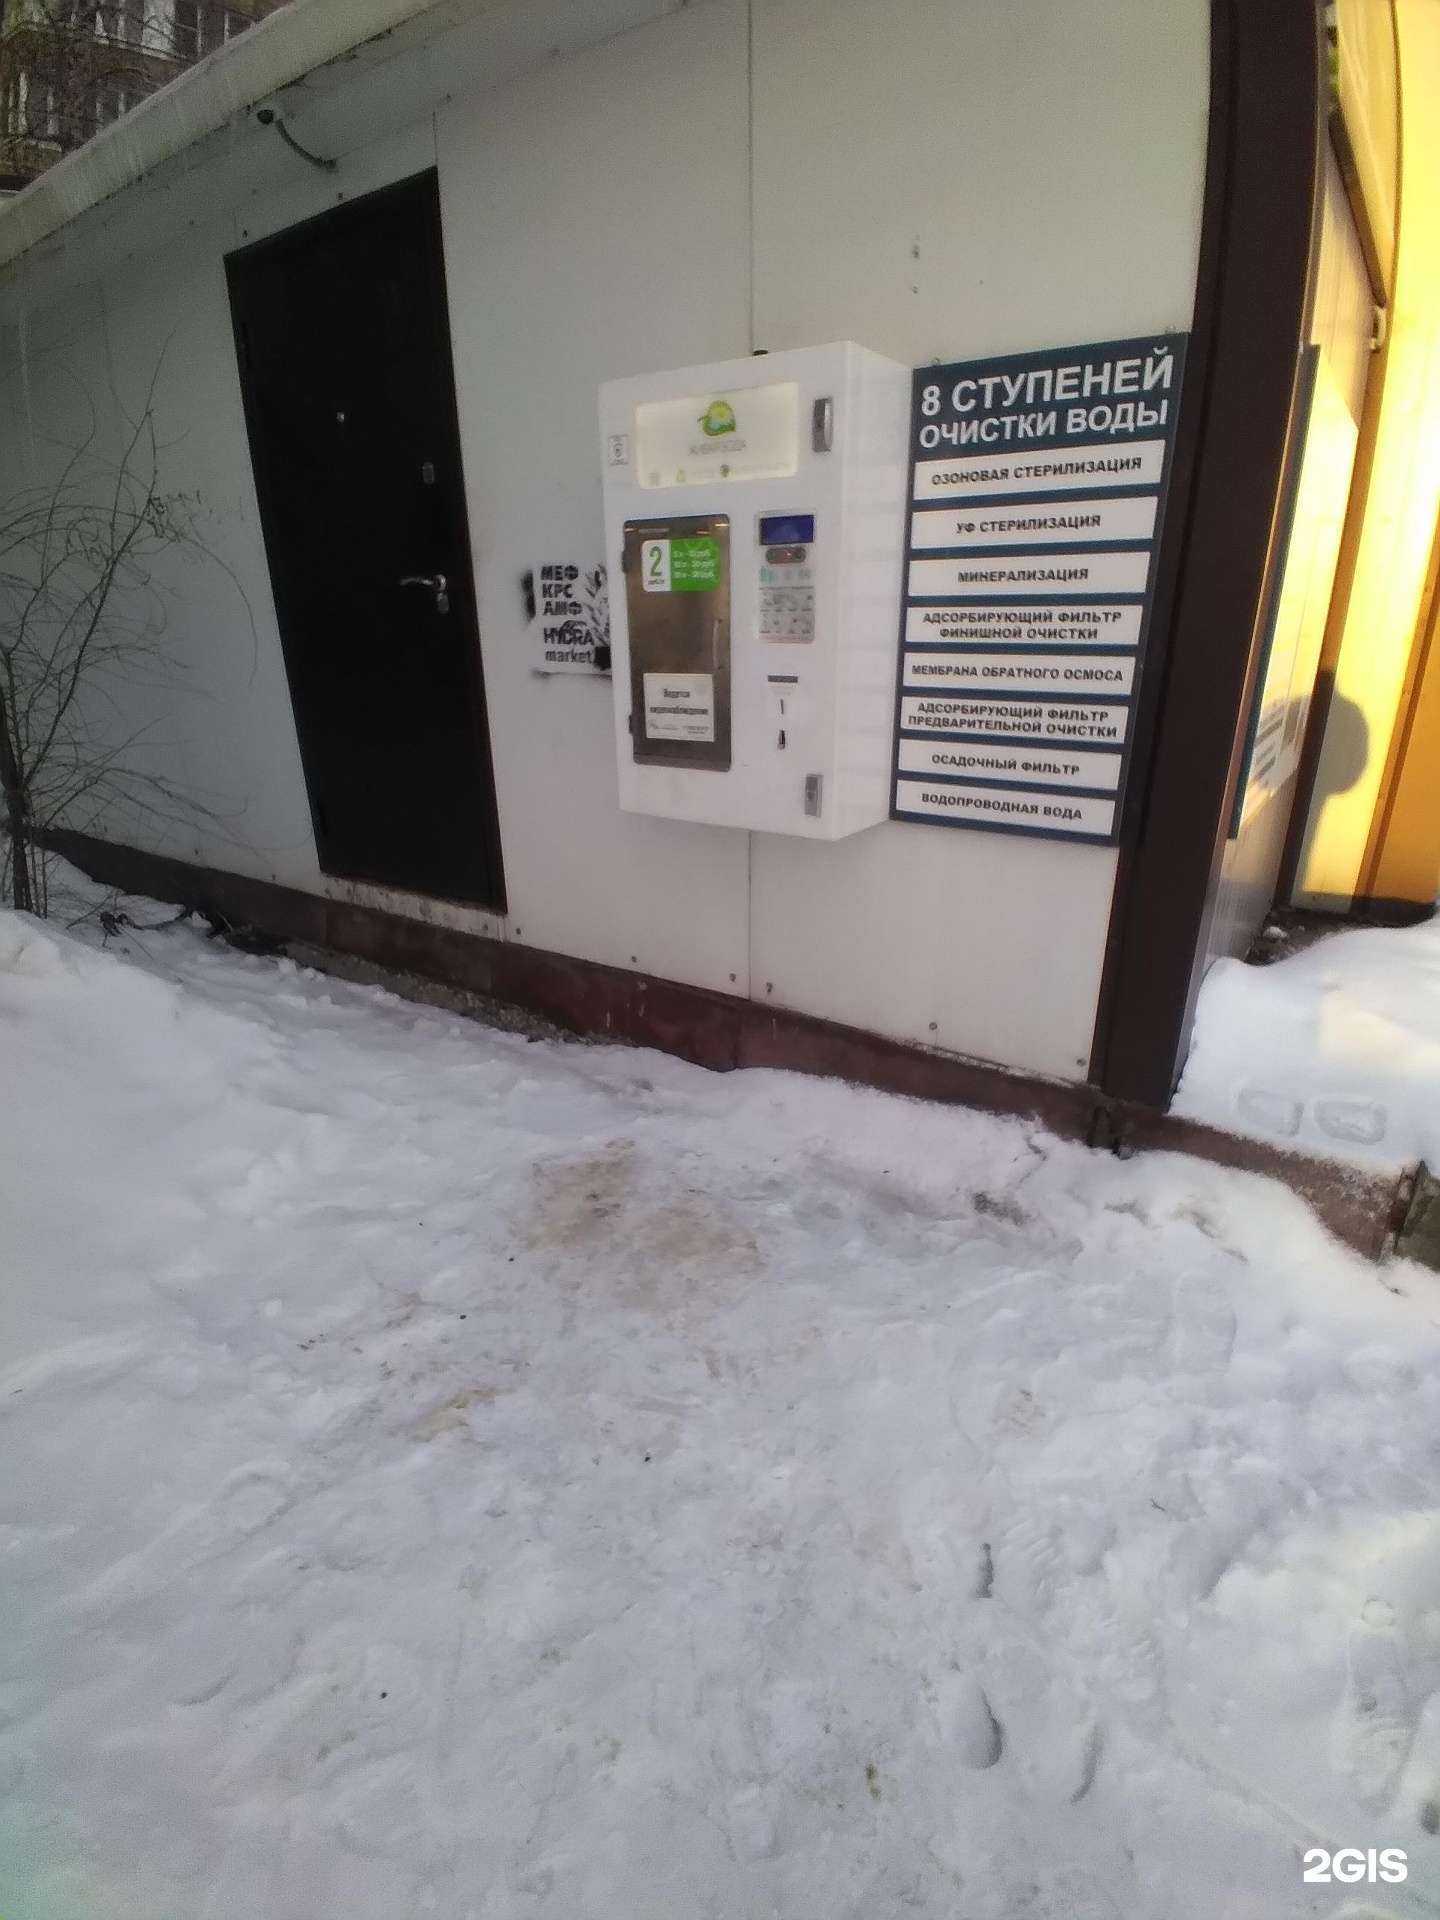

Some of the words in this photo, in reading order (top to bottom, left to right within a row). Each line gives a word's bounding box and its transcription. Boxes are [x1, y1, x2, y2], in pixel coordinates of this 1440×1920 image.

[921, 385, 941, 416] 8
[951, 346, 1174, 412] СТУПЕНЕЙ
[919, 411, 1057, 448] ОЧИСТКИ
[1066, 399, 1168, 434] ВОДЫ
[931, 468, 1008, 486] ОЗОНОВАЯ
[1013, 457, 1142, 479] СТЕРИЛИЗАЦИЯ
[956, 522, 975, 534] УФ
[980, 515, 1101, 533] СТЕРИЛИЗАЦИЯ
[649, 546, 662, 576] 2
[957, 568, 1089, 583] МИНЕРАЛИЗАЦИЯ
[923, 610, 1053, 625] АДСОРБИРУЮЩИЙ
[1057, 611, 1122, 623] ФИЛЬТР
[543, 626, 594, 645] HYDRA
[940, 626, 1022, 639] ФИНИШНОЙ
[1026, 627, 1098, 639] ОЧИСТКИ
[545, 649, 593, 664] market
[912, 664, 978, 677] МЕМБРАНА
[981, 666, 1059, 680] ОБРАТНОГО
[1063, 669, 1123, 681] ОСМОСА
[917, 702, 1043, 719] АДСОРБИРУЮЩИЙ
[1047, 709, 1109, 722] ФИЛЬТР
[908, 715, 1041, 733] ПРЕДВАРИТЕЛЬНОЙ
[1046, 722, 1117, 738] ОЧИСТКИ
[932, 754, 1017, 770] ОСАДОЧНЫЙ
[1021, 761, 1080, 775] ФИЛЬТР
[921, 792, 1039, 815] ВОДОПРОВОДНАЯ
[1043, 806, 1082, 820] ВОДА
